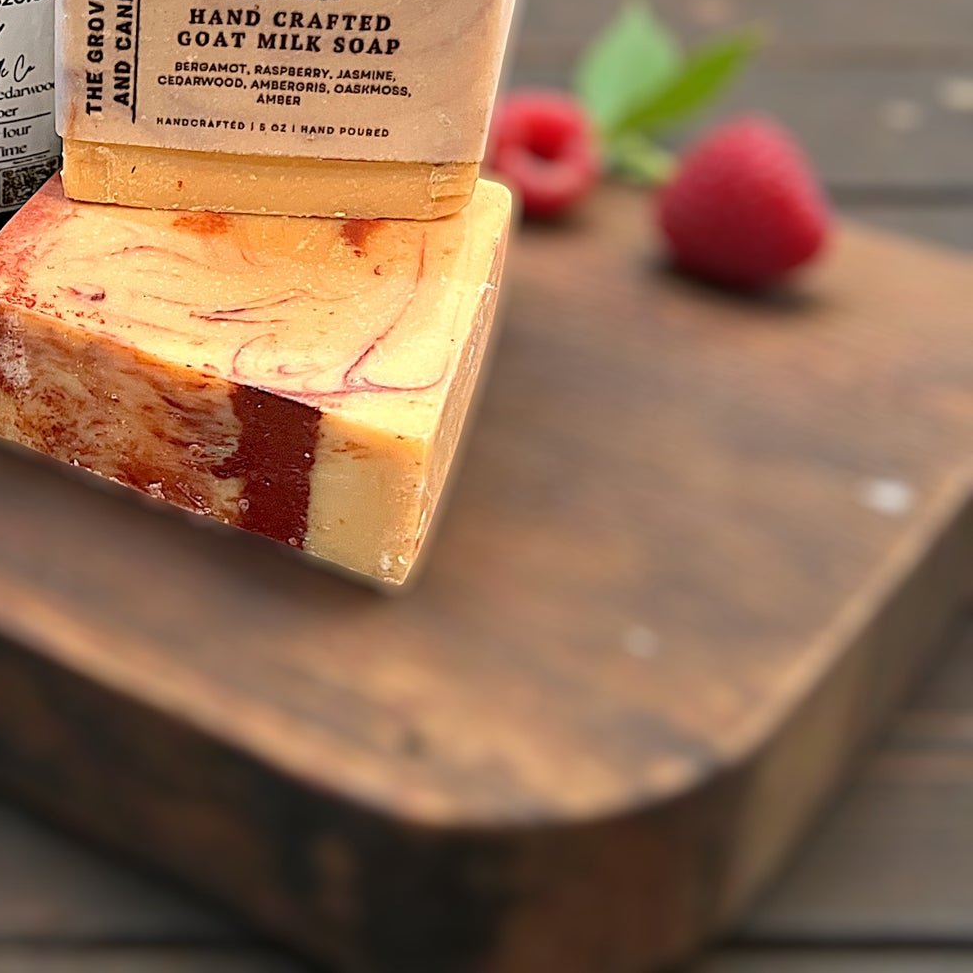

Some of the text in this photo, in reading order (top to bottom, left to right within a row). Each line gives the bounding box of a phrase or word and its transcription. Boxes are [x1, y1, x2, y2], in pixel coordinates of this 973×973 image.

[189, 8, 392, 32] HAND CRAFTED
[177, 31, 400, 56] GOAT MILK SOAP
[175, 61, 397, 82] BERGAMOT, RASPBERRY, JASMINE,
[85, 70, 103, 116] THE
[113, 60, 132, 107] AND
[157, 75, 412, 98] CEDARWOOD, AMBERGRIS, OASKMOSS,
[256, 93, 302, 106] AMBER
[156, 117, 246, 130] HANDCRAFTED
[259, 122, 266, 132] 5
[271, 123, 287, 133] OZ
[300, 125, 335, 135] HAND
[339, 127, 390, 138] POURED
